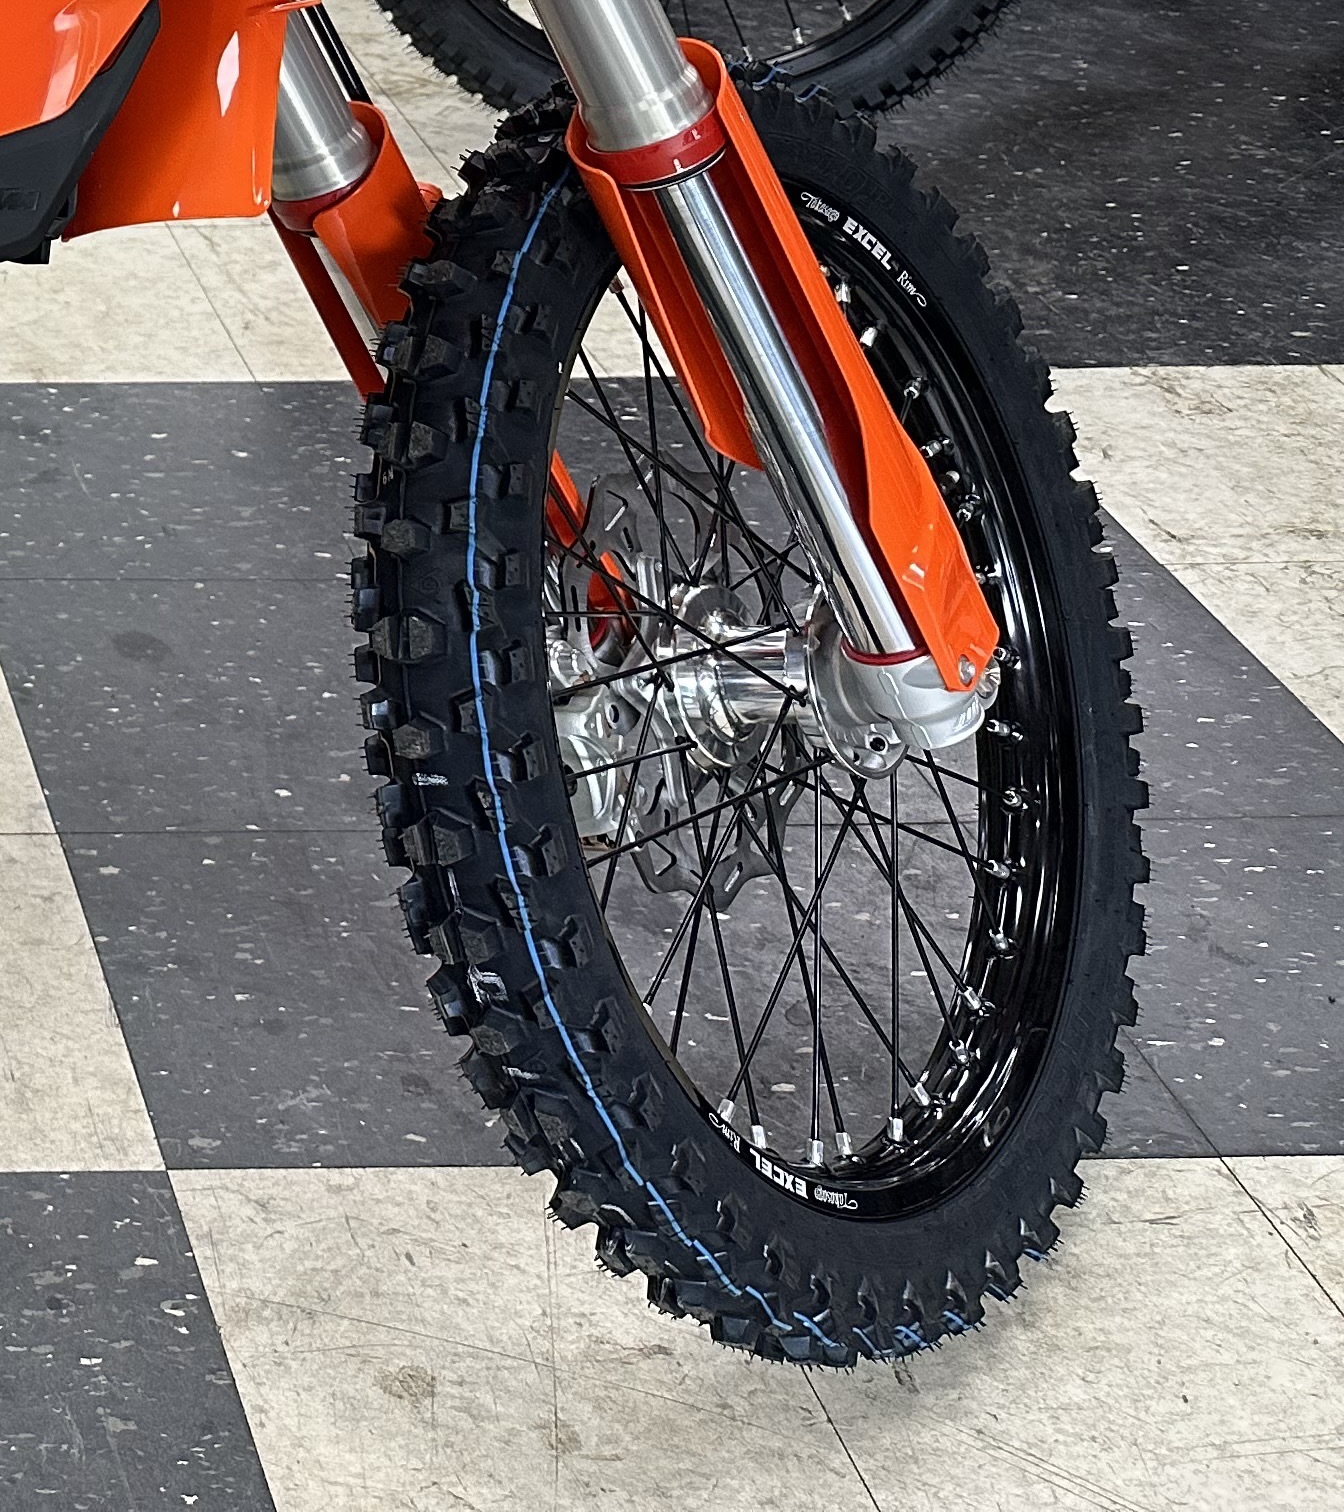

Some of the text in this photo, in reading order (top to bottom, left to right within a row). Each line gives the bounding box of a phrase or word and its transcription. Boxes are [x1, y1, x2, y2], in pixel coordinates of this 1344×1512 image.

[842, 216, 892, 271] EXCEL
[897, 270, 927, 307] Rim
[709, 1112, 740, 1154] Rim
[749, 1147, 809, 1200] EXCEL
